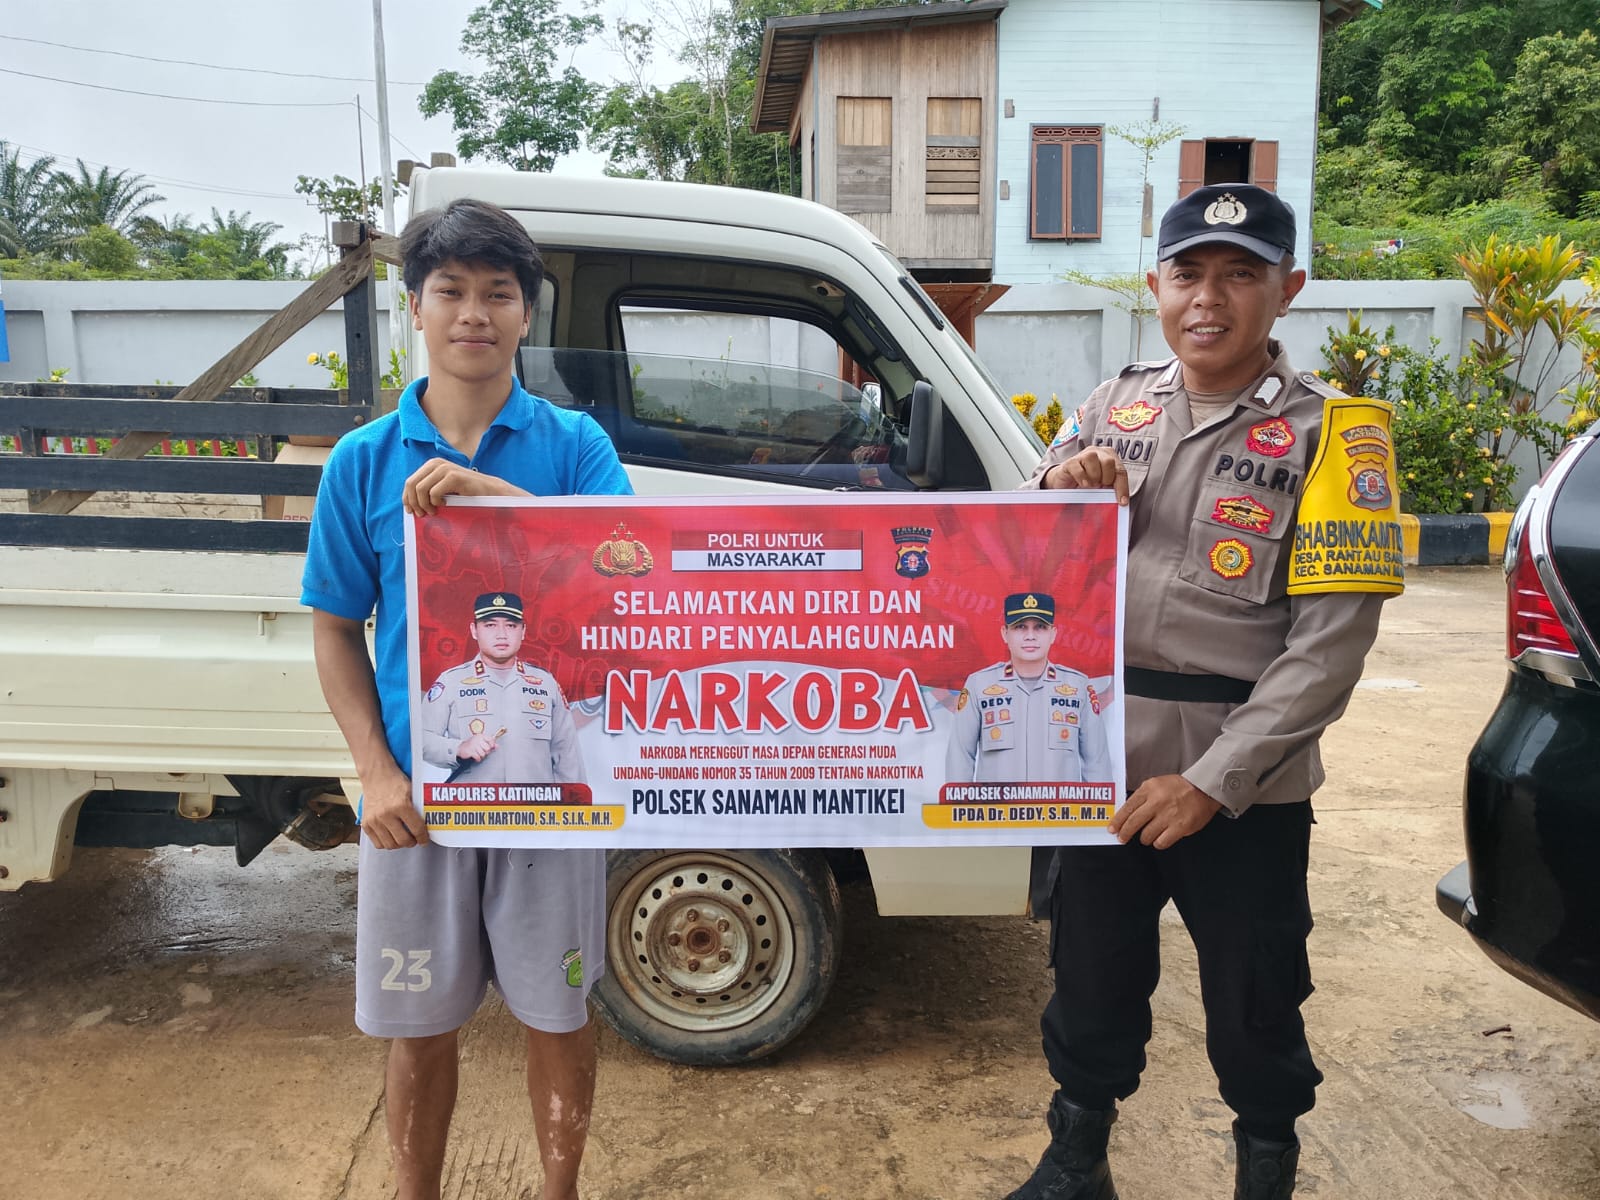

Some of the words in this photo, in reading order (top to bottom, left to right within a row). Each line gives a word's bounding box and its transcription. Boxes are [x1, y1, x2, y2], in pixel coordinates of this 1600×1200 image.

[1215, 454, 1298, 494] POLRI
[708, 533, 759, 548] POLRI
[764, 533, 824, 547] UNTUK
[707, 552, 825, 567] MASYARAKAT
[1295, 551, 1322, 566] DESA
[1295, 564, 1320, 578] KEC.
[1323, 563, 1391, 577] SANAMAN
[613, 590, 795, 615] SELAMATKAN
[804, 590, 861, 614] DIRI
[870, 590, 922, 613] DAN
[581, 626, 693, 650] HINDARI
[702, 624, 954, 650] PENYALAHGUNAAN
[459, 687, 487, 698] DODIK
[522, 686, 549, 698] POLRI
[605, 668, 934, 735] NARKOBA
[981, 696, 1013, 709] DEDY
[1051, 697, 1080, 709] POLRI
[640, 746, 687, 759] NARKOBA
[690, 746, 749, 759] MERENGGUT
[752, 746, 780, 759] MASA
[783, 746, 815, 759] DEPAN
[818, 745, 867, 759] GENERASI
[869, 745, 897, 759] MUDA
[613, 766, 699, 780] UNDANG-UNDANG
[702, 766, 737, 780] NOMOR
[739, 767, 751, 780] 35
[755, 767, 787, 779] TAHUN
[790, 766, 815, 779] 2009
[818, 766, 864, 779] TENTANG
[867, 766, 924, 779] NARKOTIKA
[432, 787, 496, 802] KAPOLRES
[498, 787, 562, 802] KATINGAN
[946, 786, 1001, 801] KAPOLSEK
[1003, 786, 1056, 801] SANAMAN
[1058, 786, 1112, 801] MANTIKEI
[632, 789, 706, 815] POLSEK
[712, 789, 806, 815] SANAMAN
[812, 788, 905, 814] MANTIKEI
[425, 811, 452, 826] AKBP
[454, 811, 485, 826] DODIK
[487, 811, 538, 827] HARTONO,
[591, 811, 613, 826] M.H.
[953, 807, 985, 822] IPDA
[988, 807, 1006, 821] Dr.
[1009, 806, 1046, 822] DEDY,
[1080, 807, 1110, 820] M.H.
[381, 948, 432, 992] 23
